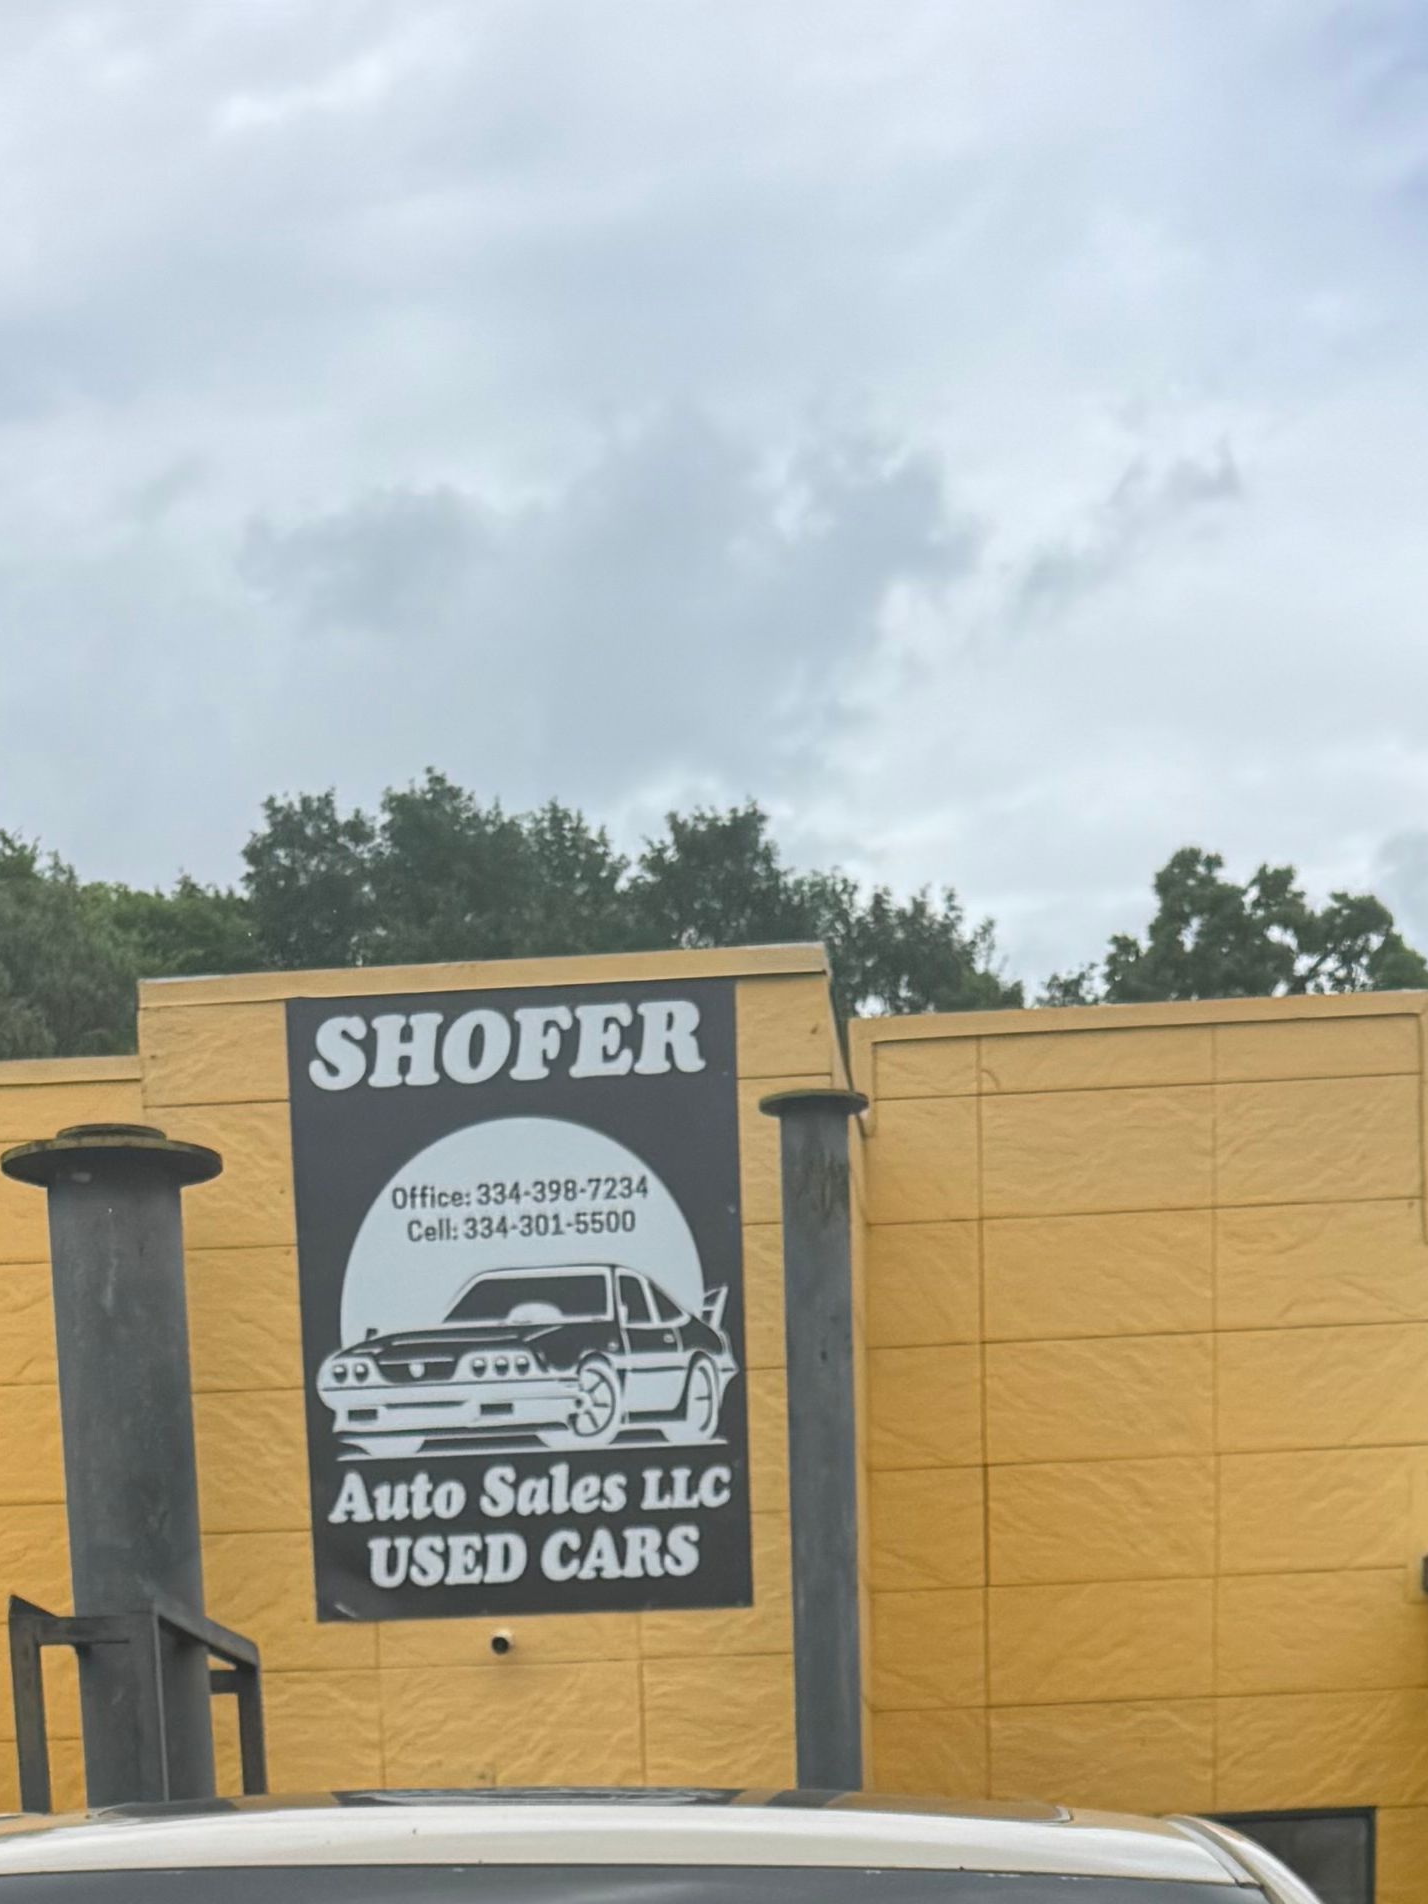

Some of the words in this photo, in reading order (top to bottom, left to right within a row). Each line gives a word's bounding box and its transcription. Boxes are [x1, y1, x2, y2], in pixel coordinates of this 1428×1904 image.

[308, 1000, 707, 1091] SHOFER
[391, 1186, 471, 1210] Office:
[476, 1175, 649, 1206] 334-398-7234
[407, 1219, 459, 1243] Cell:
[464, 1209, 636, 1241] 334-301-5500
[328, 1470, 466, 1525] Auto
[479, 1463, 627, 1518] Sales
[640, 1465, 732, 1511] LLC
[368, 1534, 528, 1588] USED
[540, 1524, 702, 1582] CARS
